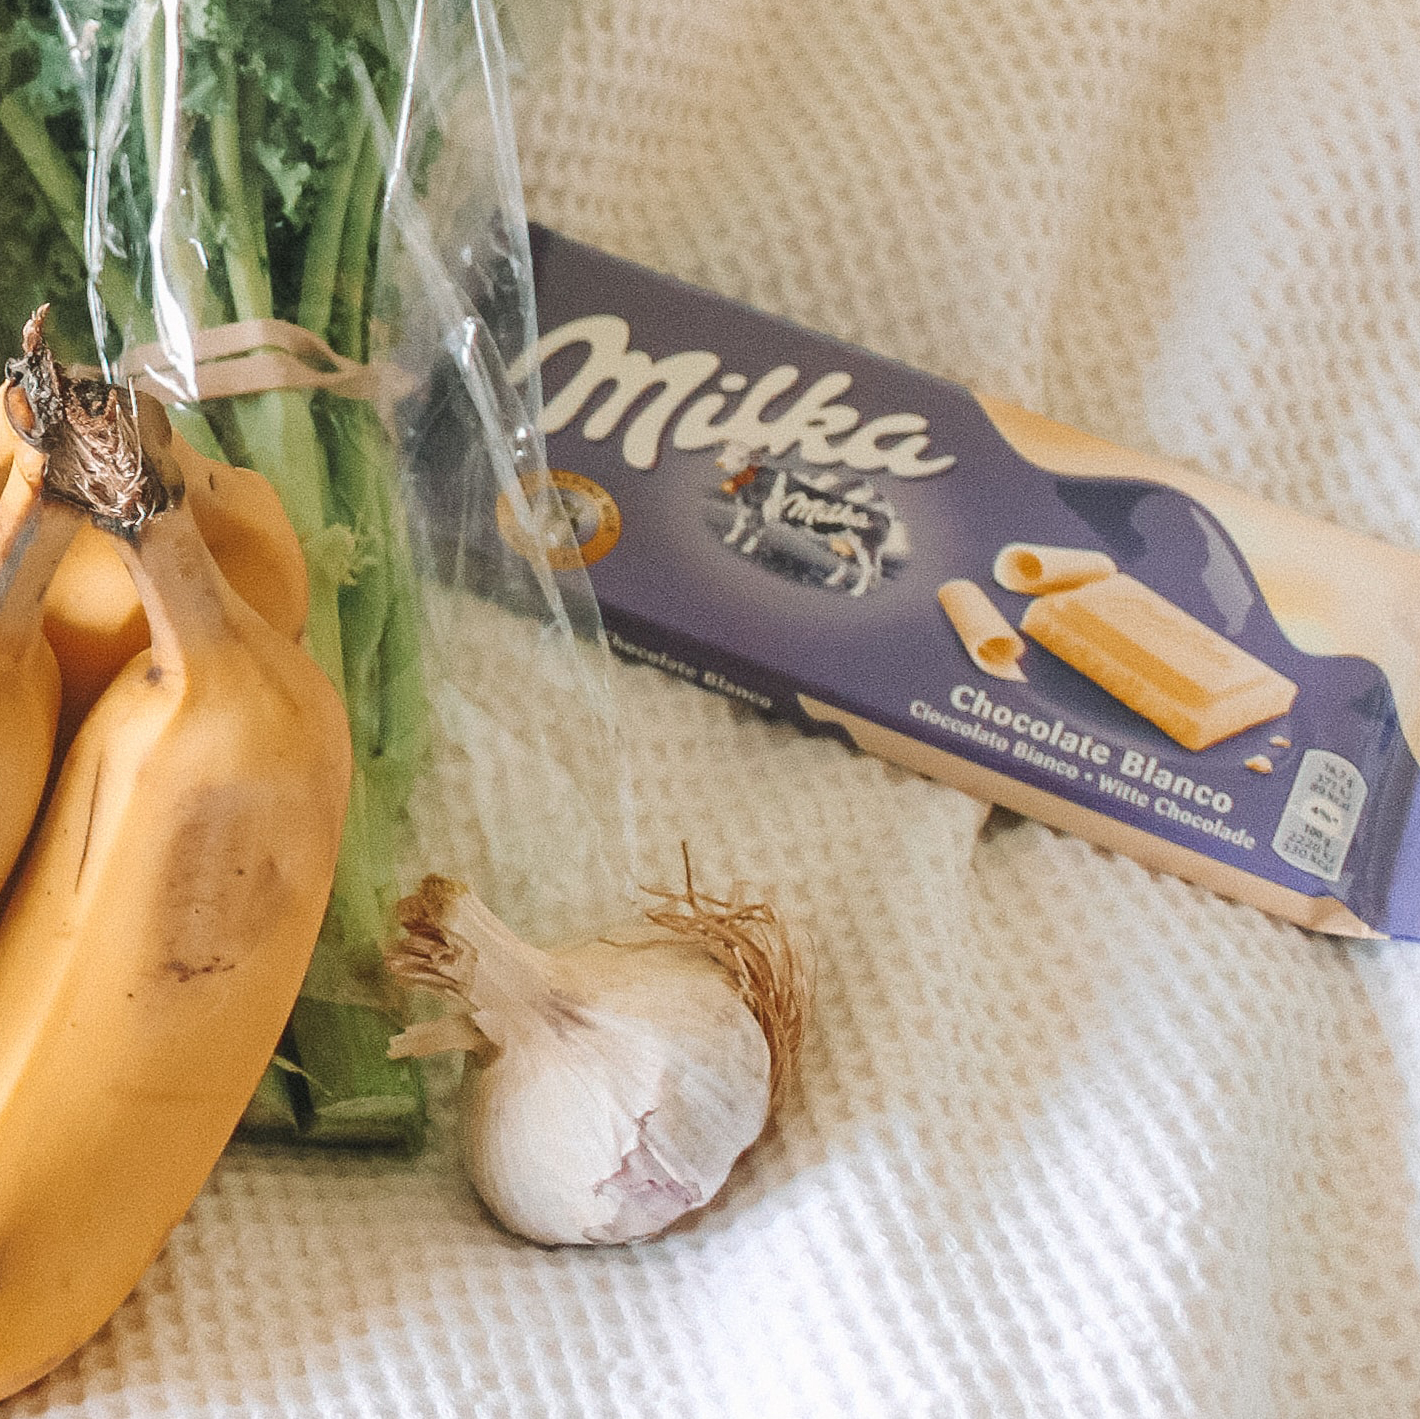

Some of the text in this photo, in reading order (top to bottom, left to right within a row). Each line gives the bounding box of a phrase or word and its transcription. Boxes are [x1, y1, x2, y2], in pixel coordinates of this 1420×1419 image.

[505, 313, 958, 479] Milka
[949, 683, 1235, 815] Chocolate Blanco
[1012, 740, 1081, 781] Blanco
[1098, 772, 1151, 809] Witte
[1154, 796, 1258, 851] Chocolade
